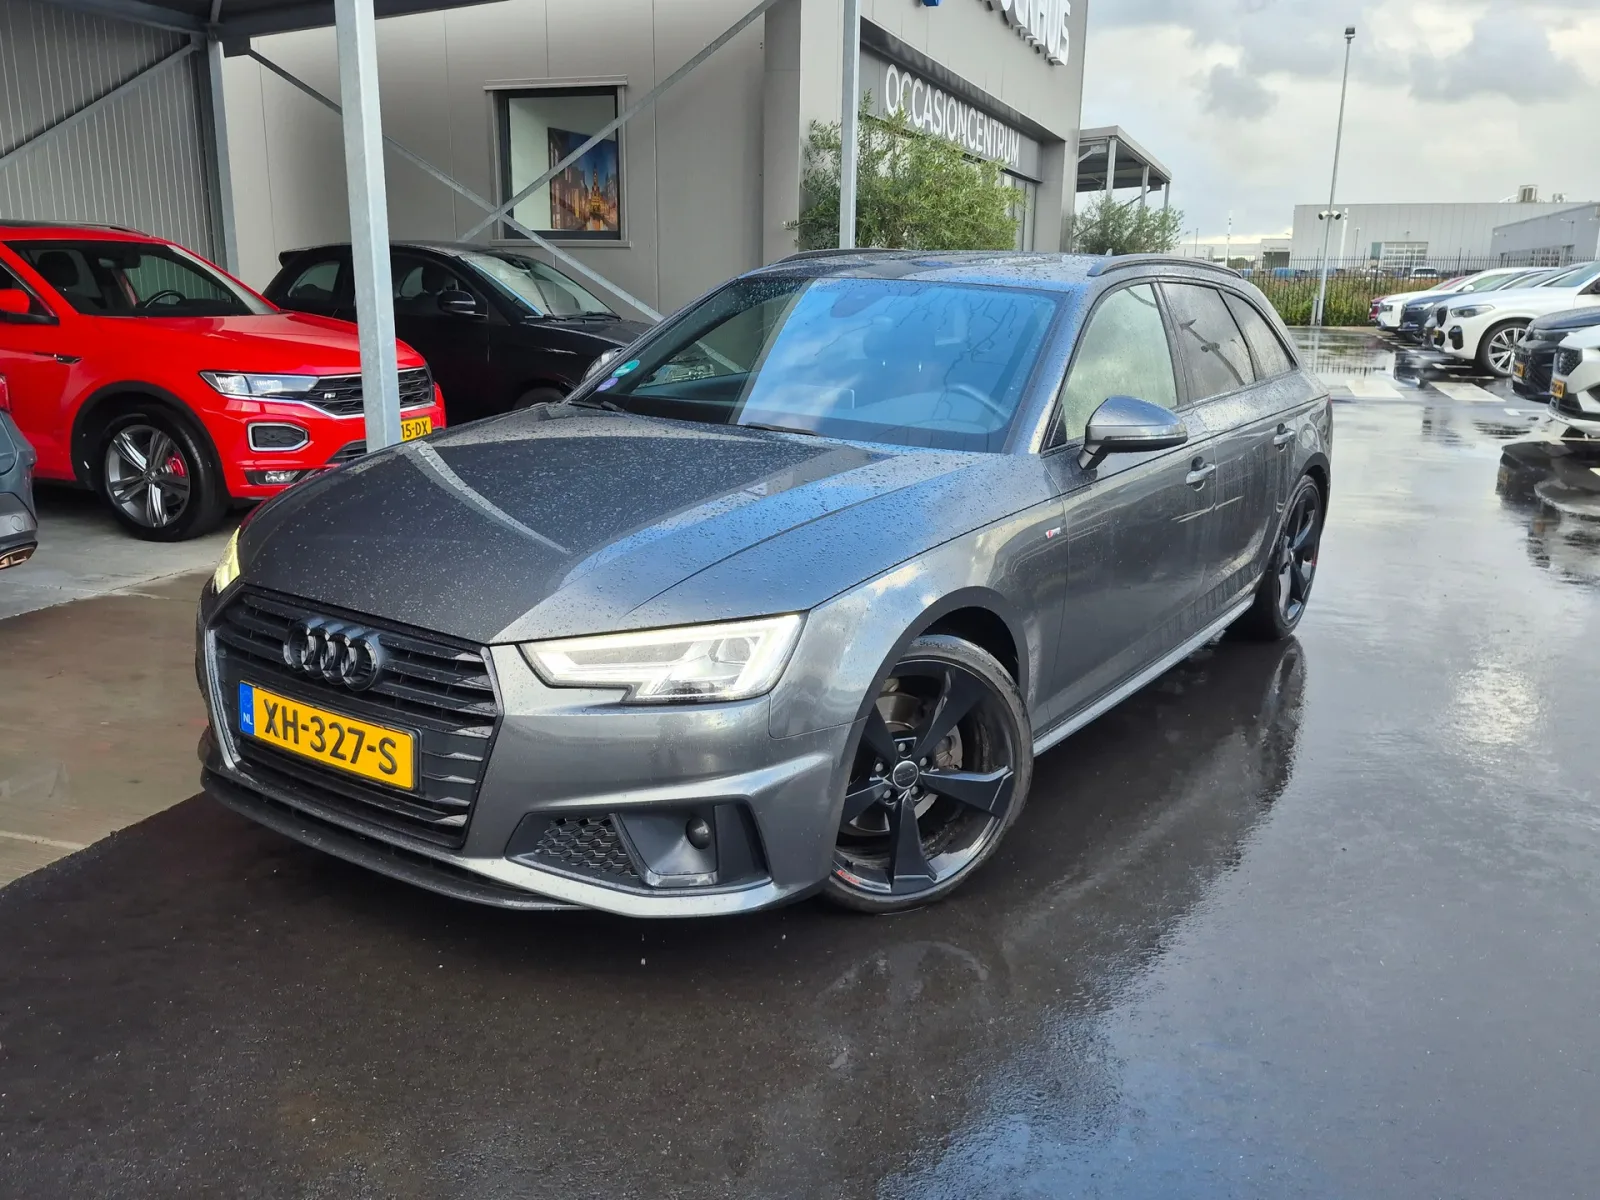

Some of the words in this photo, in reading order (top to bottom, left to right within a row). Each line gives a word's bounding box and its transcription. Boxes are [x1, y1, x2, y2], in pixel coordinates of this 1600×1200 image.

[886, 64, 1020, 168] OCCASIONCENTRUM
[401, 420, 428, 439] 15-DX
[242, 711, 254, 726] NL
[263, 698, 397, 776] XH-327-S
